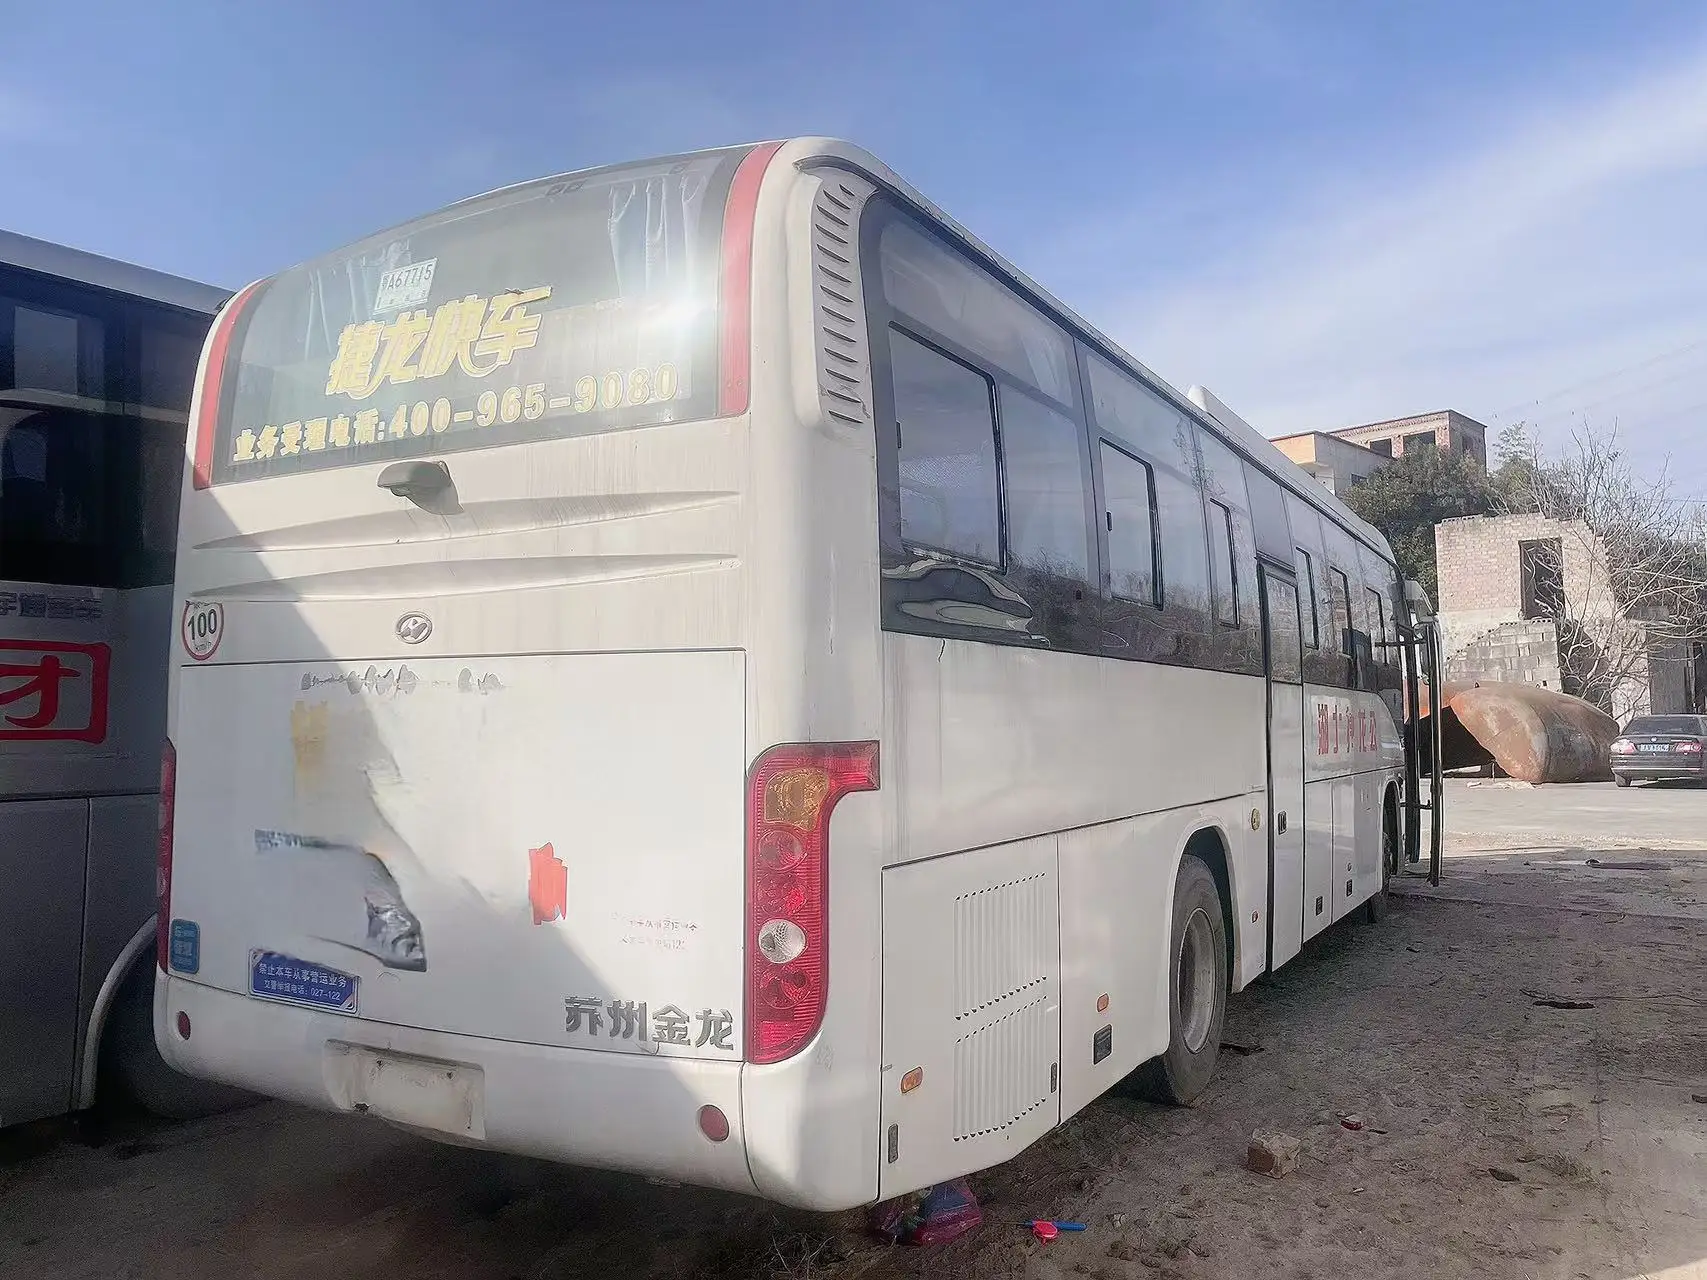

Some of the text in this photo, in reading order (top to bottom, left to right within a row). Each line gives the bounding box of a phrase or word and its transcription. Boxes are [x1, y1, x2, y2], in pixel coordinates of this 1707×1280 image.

[187, 608, 218, 641] 100
[564, 995, 735, 1051] 苏州金龙
